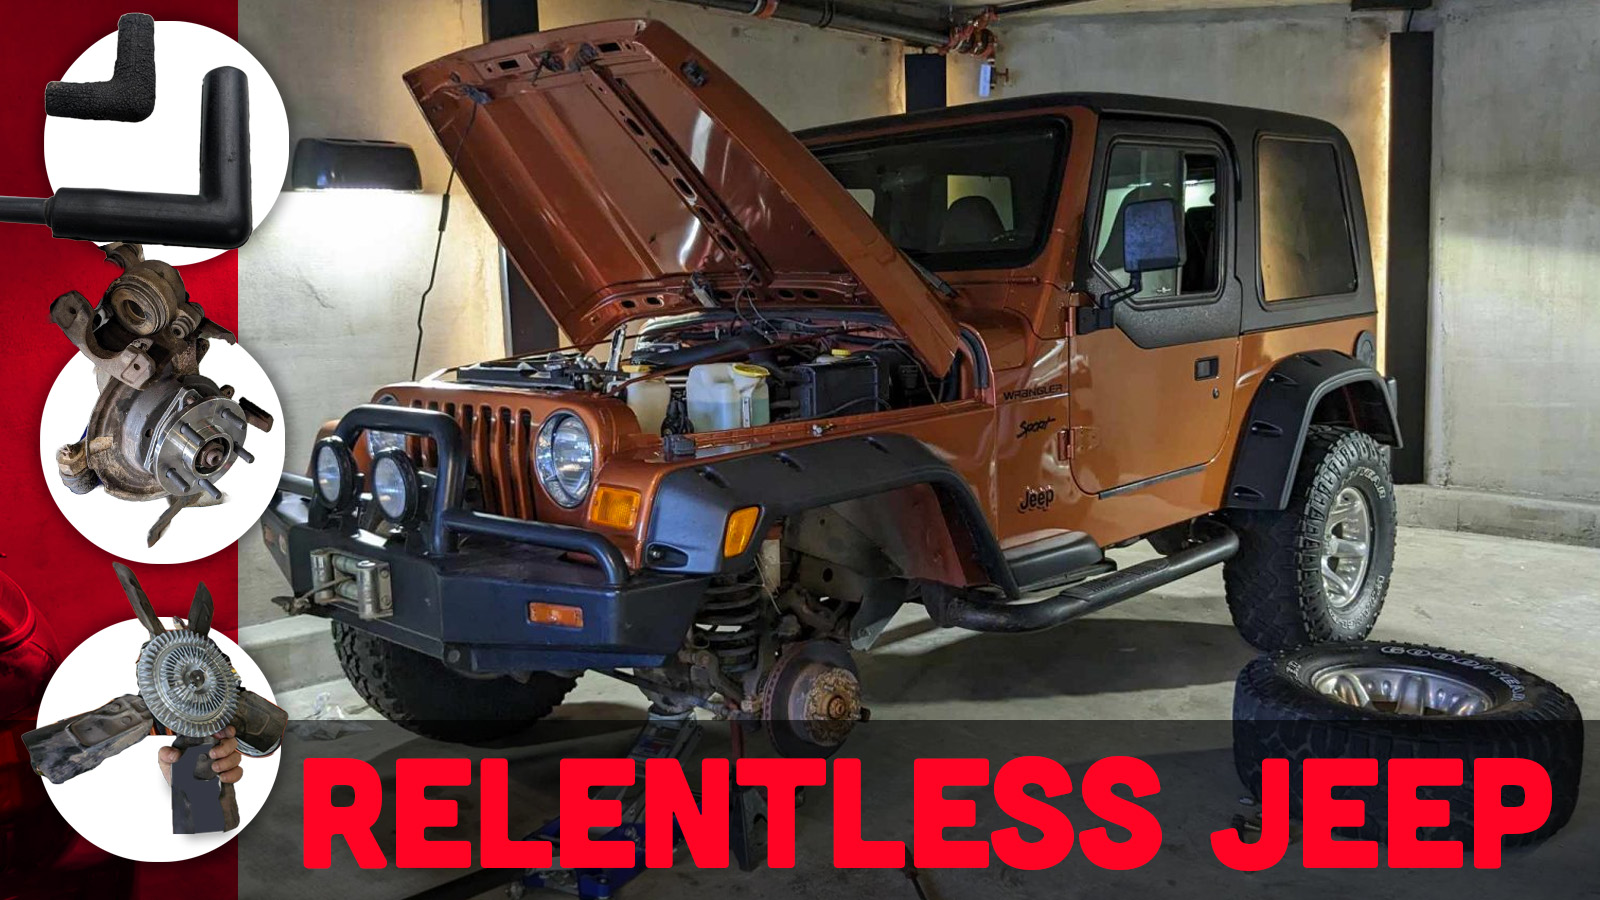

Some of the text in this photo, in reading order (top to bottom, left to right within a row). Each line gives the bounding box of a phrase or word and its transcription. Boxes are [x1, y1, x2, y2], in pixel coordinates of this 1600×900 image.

[1003, 384, 1063, 400] WRANGLER
[1019, 486, 1055, 512] Jeep
[1380, 645, 1526, 702] GOODYEAR
